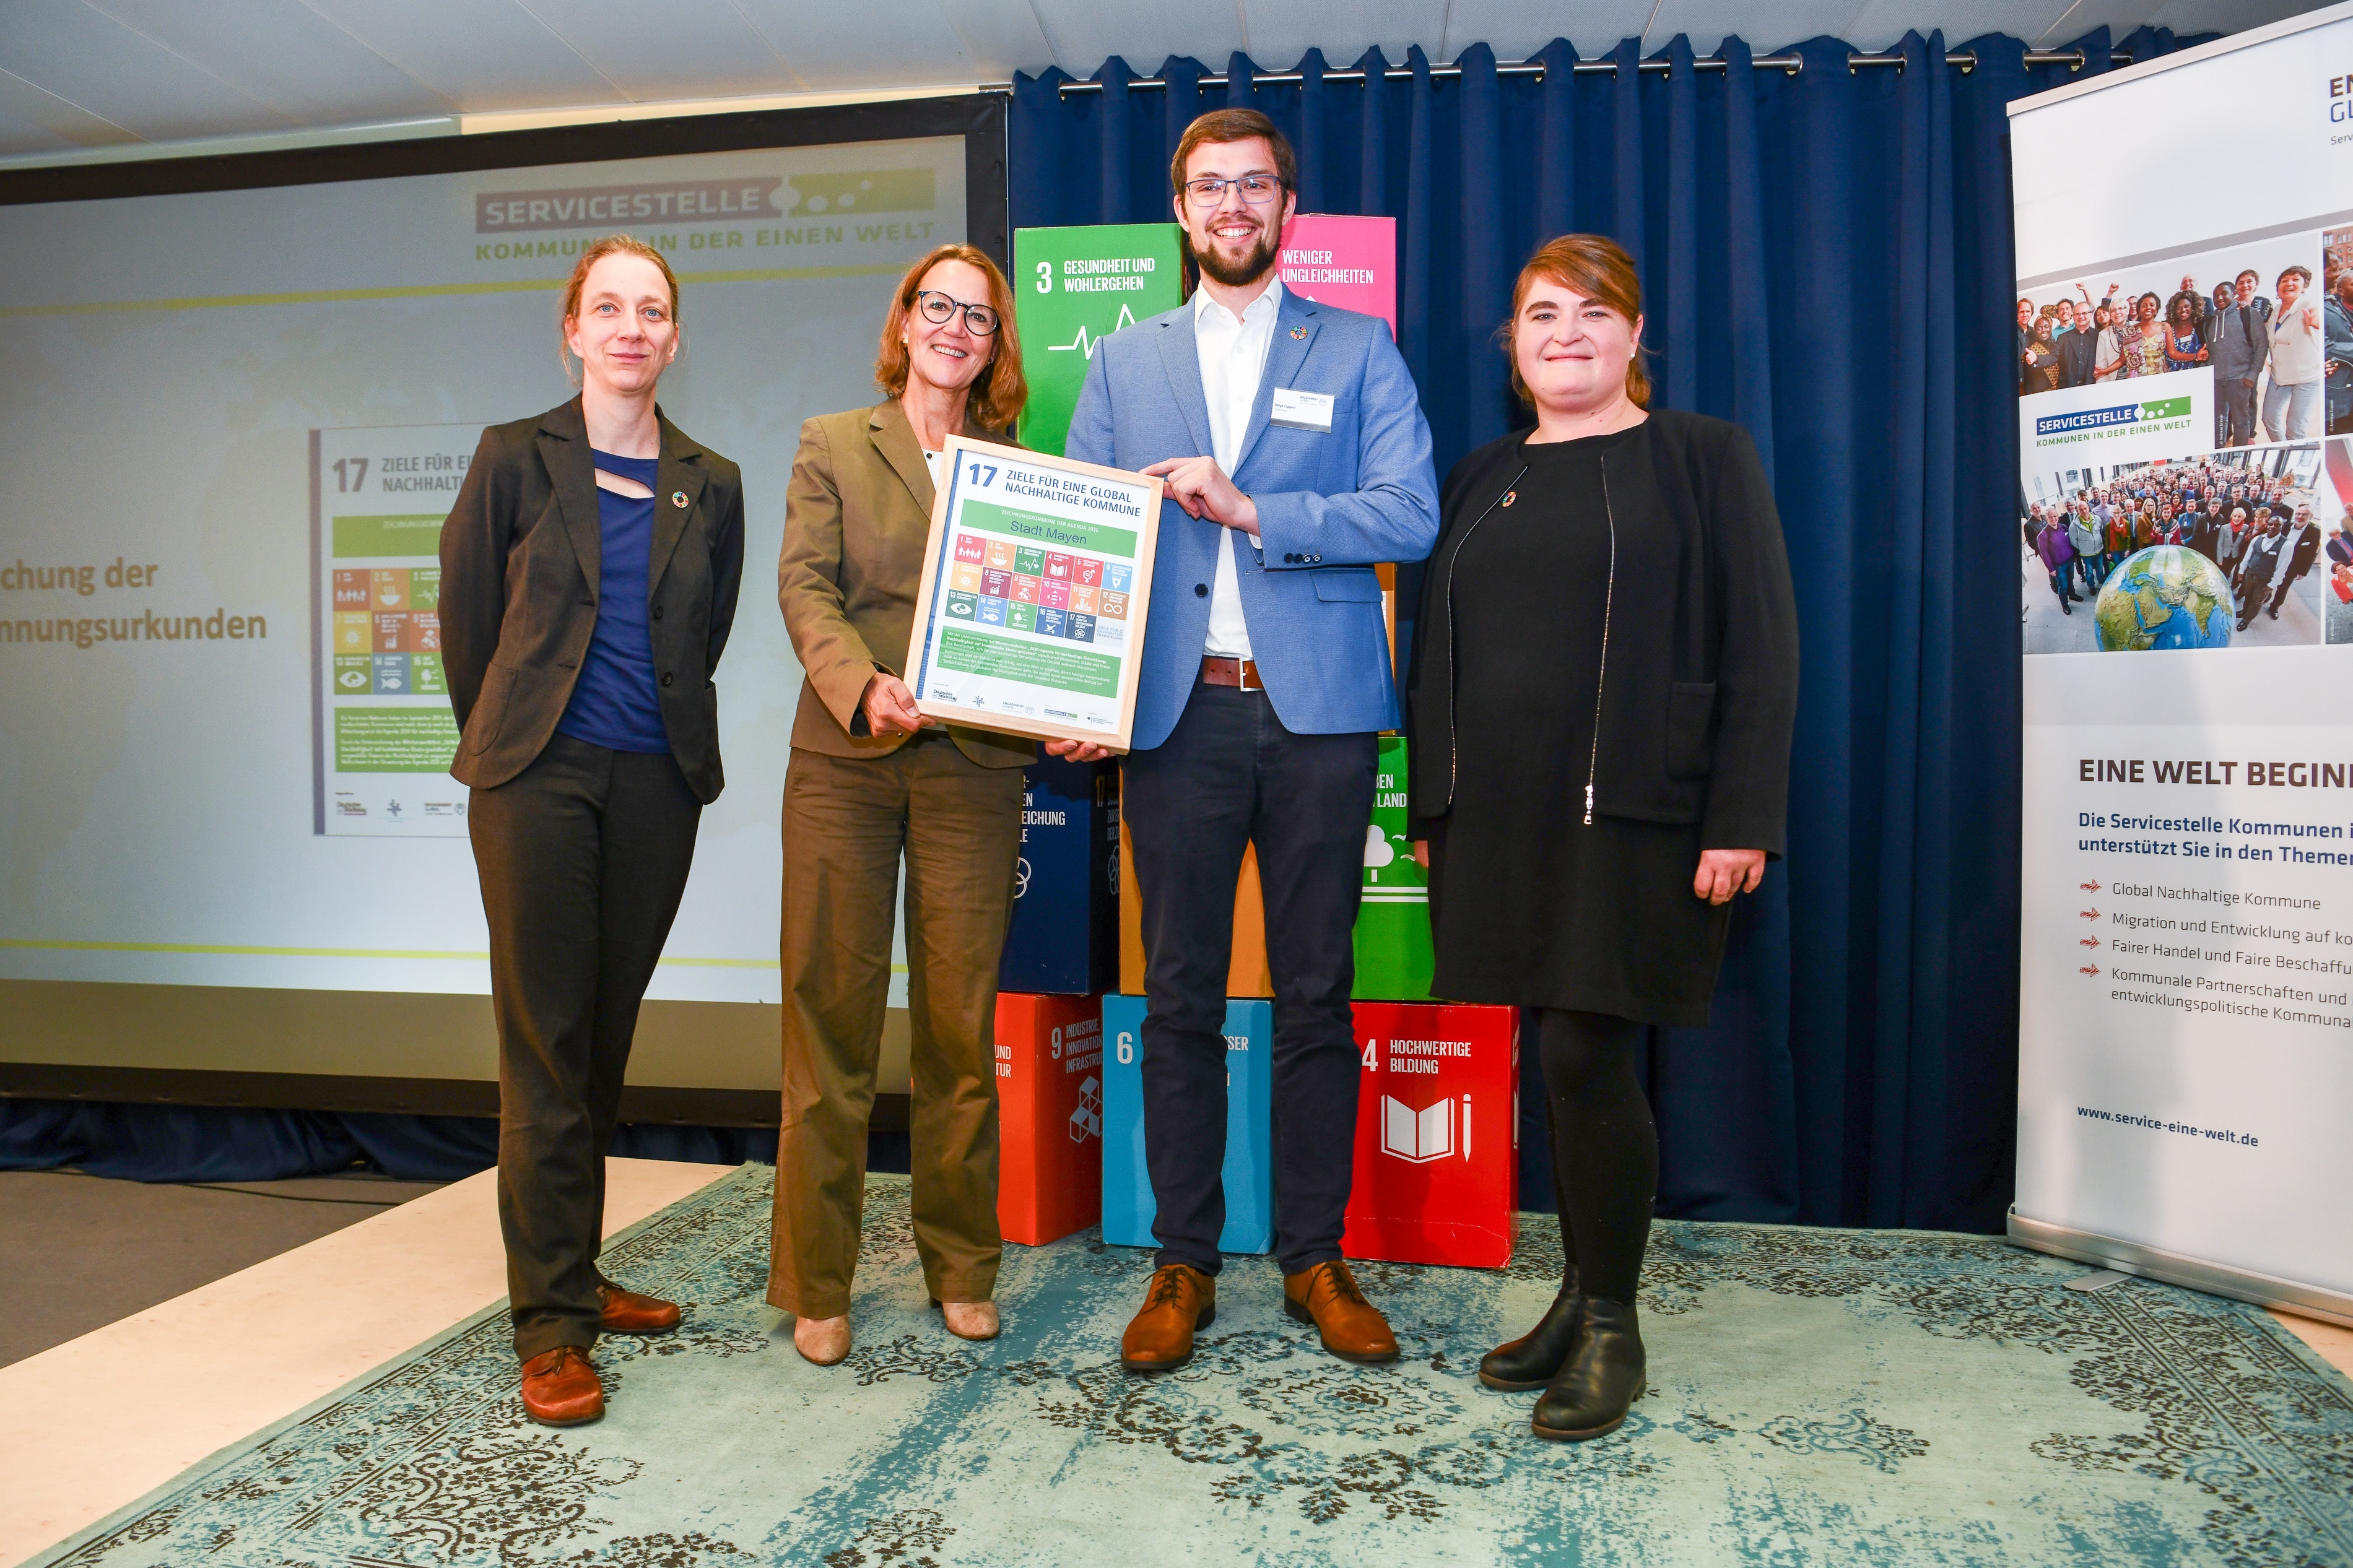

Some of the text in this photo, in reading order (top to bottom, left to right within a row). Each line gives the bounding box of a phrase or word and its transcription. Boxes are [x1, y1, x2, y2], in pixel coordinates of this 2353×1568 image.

[485, 188, 760, 225] SERVICESTELLE
[689, 231, 743, 249] DER
[756, 227, 843, 247] EINEN
[856, 223, 934, 241] WELT
[1283, 249, 1332, 265] WENIGER
[1036, 258, 1155, 294] 3 GESUNDHEIT UND
[1064, 277, 1144, 292] WOHLERGEHEN
[1283, 268, 1373, 284] UNGLEICHHEITEN
[2037, 420, 2191, 447] KOMMUNEN IN DER EINEN WELT
[2039, 409, 2131, 432] SERVICESTELLE
[333, 454, 474, 492] 17 ZIELE FÜR EI
[966, 462, 1131, 503] 17 ZIELE FÜR EINE GLOBAL
[1005, 482, 1141, 517] NACHHALTIGE KOMMUNE
[1001, 509, 1056, 524] ZEICHNUNGSKOMMUNE
[1067, 522, 1087, 531] AGENDA
[1010, 520, 1087, 547] Stadt Mayen
[1, 557, 159, 596] chung der
[0, 608, 266, 649] nnungsurkunden
[1097, 629, 1123, 637] NACHHALTIGE
[2080, 760, 2353, 787] EINE WELT BEGIN
[1377, 793, 1407, 807] LAND
[2079, 812, 2342, 838] Die Servicestelle Kommunen
[2079, 838, 2177, 856] unterstützt
[2183, 841, 2210, 857] Sie
[2216, 842, 2232, 859] in
[2238, 844, 2273, 860] den
[2113, 883, 2321, 910] Global Nachhaltige Kommune
[2113, 913, 2353, 945] Migration und Entwicklung auf ko
[2113, 940, 2352, 974] Fairer Handel und Faire Beschaffu
[2112, 968, 2347, 1005] Kommunale Partnerschaften und
[2112, 990, 2351, 1028] entwicklungspolitische Kommuna
[1051, 1018, 1100, 1059] 9 INDUSTRIE,
[1066, 1034, 1103, 1056] INNOVATION
[1117, 1031, 1133, 1063] 6
[1224, 1036, 1248, 1050] SER
[1362, 1039, 1471, 1072] 4 HOCHWERTIGE
[1390, 1058, 1438, 1074] BILDUNG
[2077, 1107, 2259, 1146] www.service-eine-welt.de
